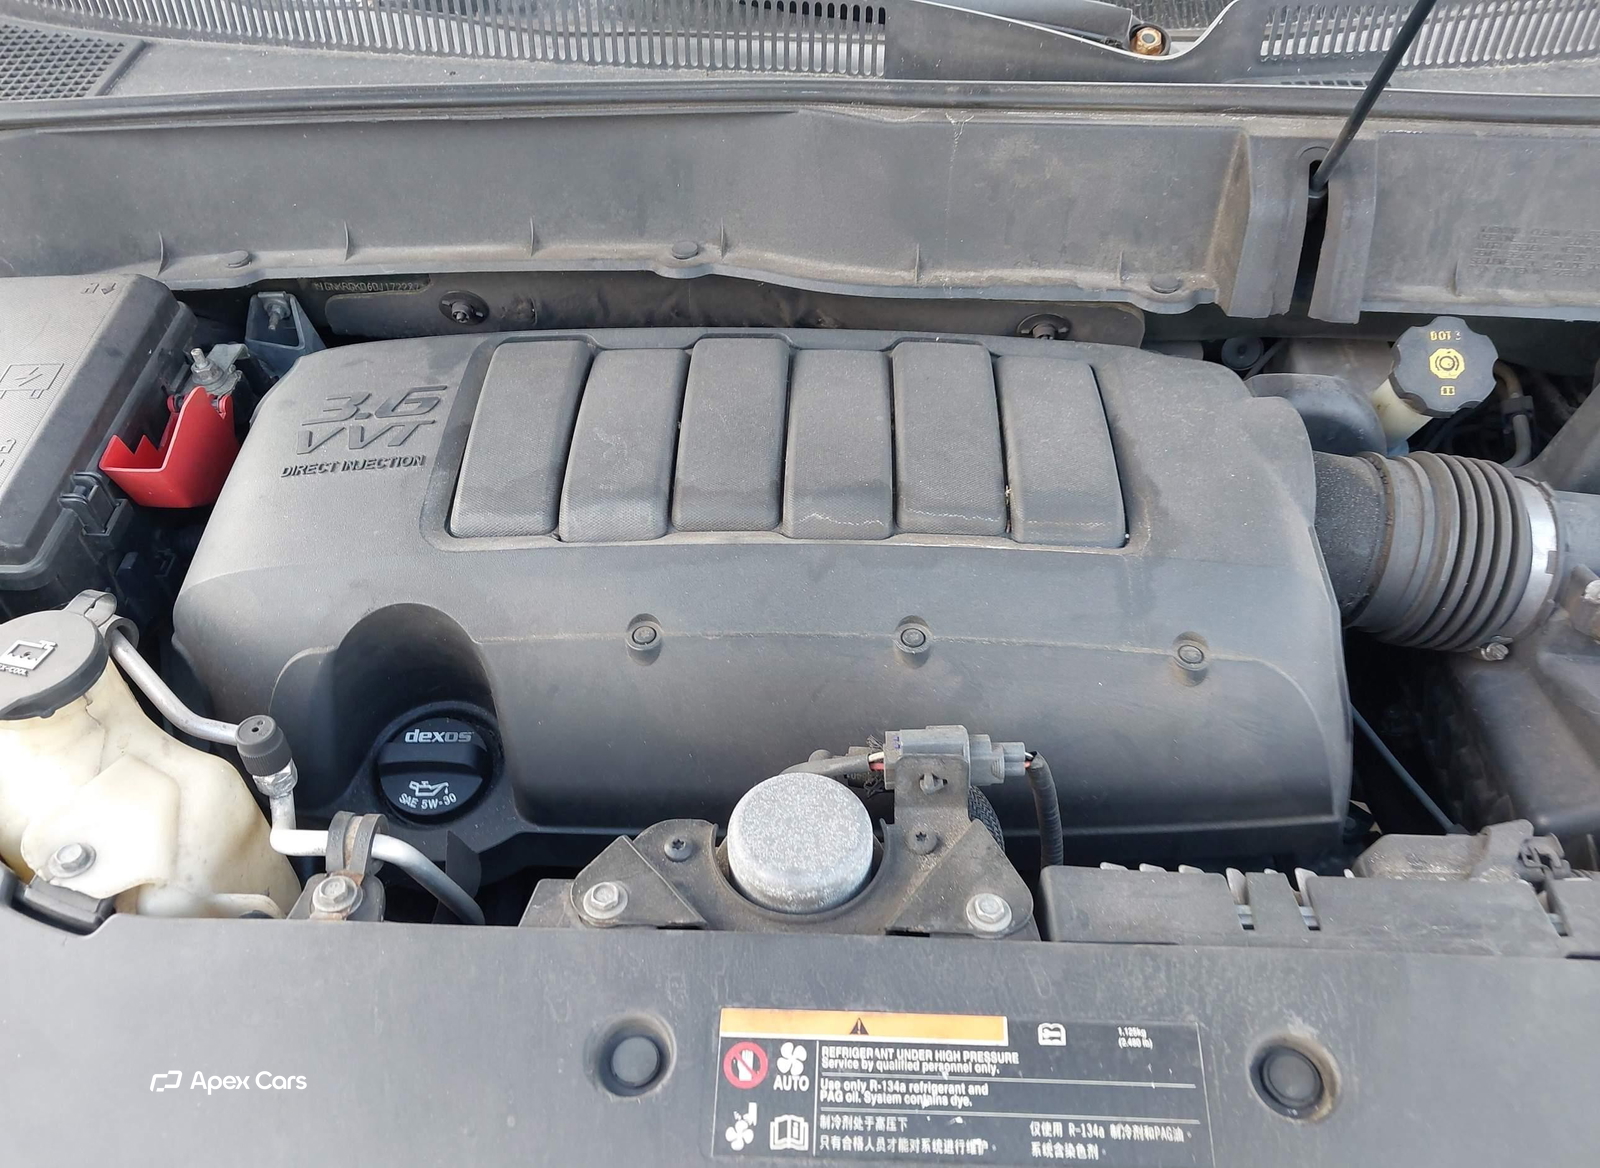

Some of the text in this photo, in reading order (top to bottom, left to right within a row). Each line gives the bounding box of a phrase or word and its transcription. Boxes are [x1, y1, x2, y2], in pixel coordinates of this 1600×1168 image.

[1430, 330, 1451, 341] DOT
[302, 385, 448, 426] 3.6
[296, 420, 436, 456] VVT
[281, 454, 427, 478] DIRECT INJECTION
[404, 729, 472, 743] dexos
[399, 793, 457, 810] SAE 5W-30
[821, 1046, 1020, 1064] REFRIGERANT UNDER HIGH PRESSURE
[821, 1057, 1000, 1077] Service by qualified personnel only.
[773, 1075, 810, 1092] AUTO
[820, 1078, 989, 1096] Use only R-134a refrigerant and
[820, 1090, 973, 1109] PAG oil. System contains dye.
[819, 1114, 909, 1132] 制冷剂处于高压下
